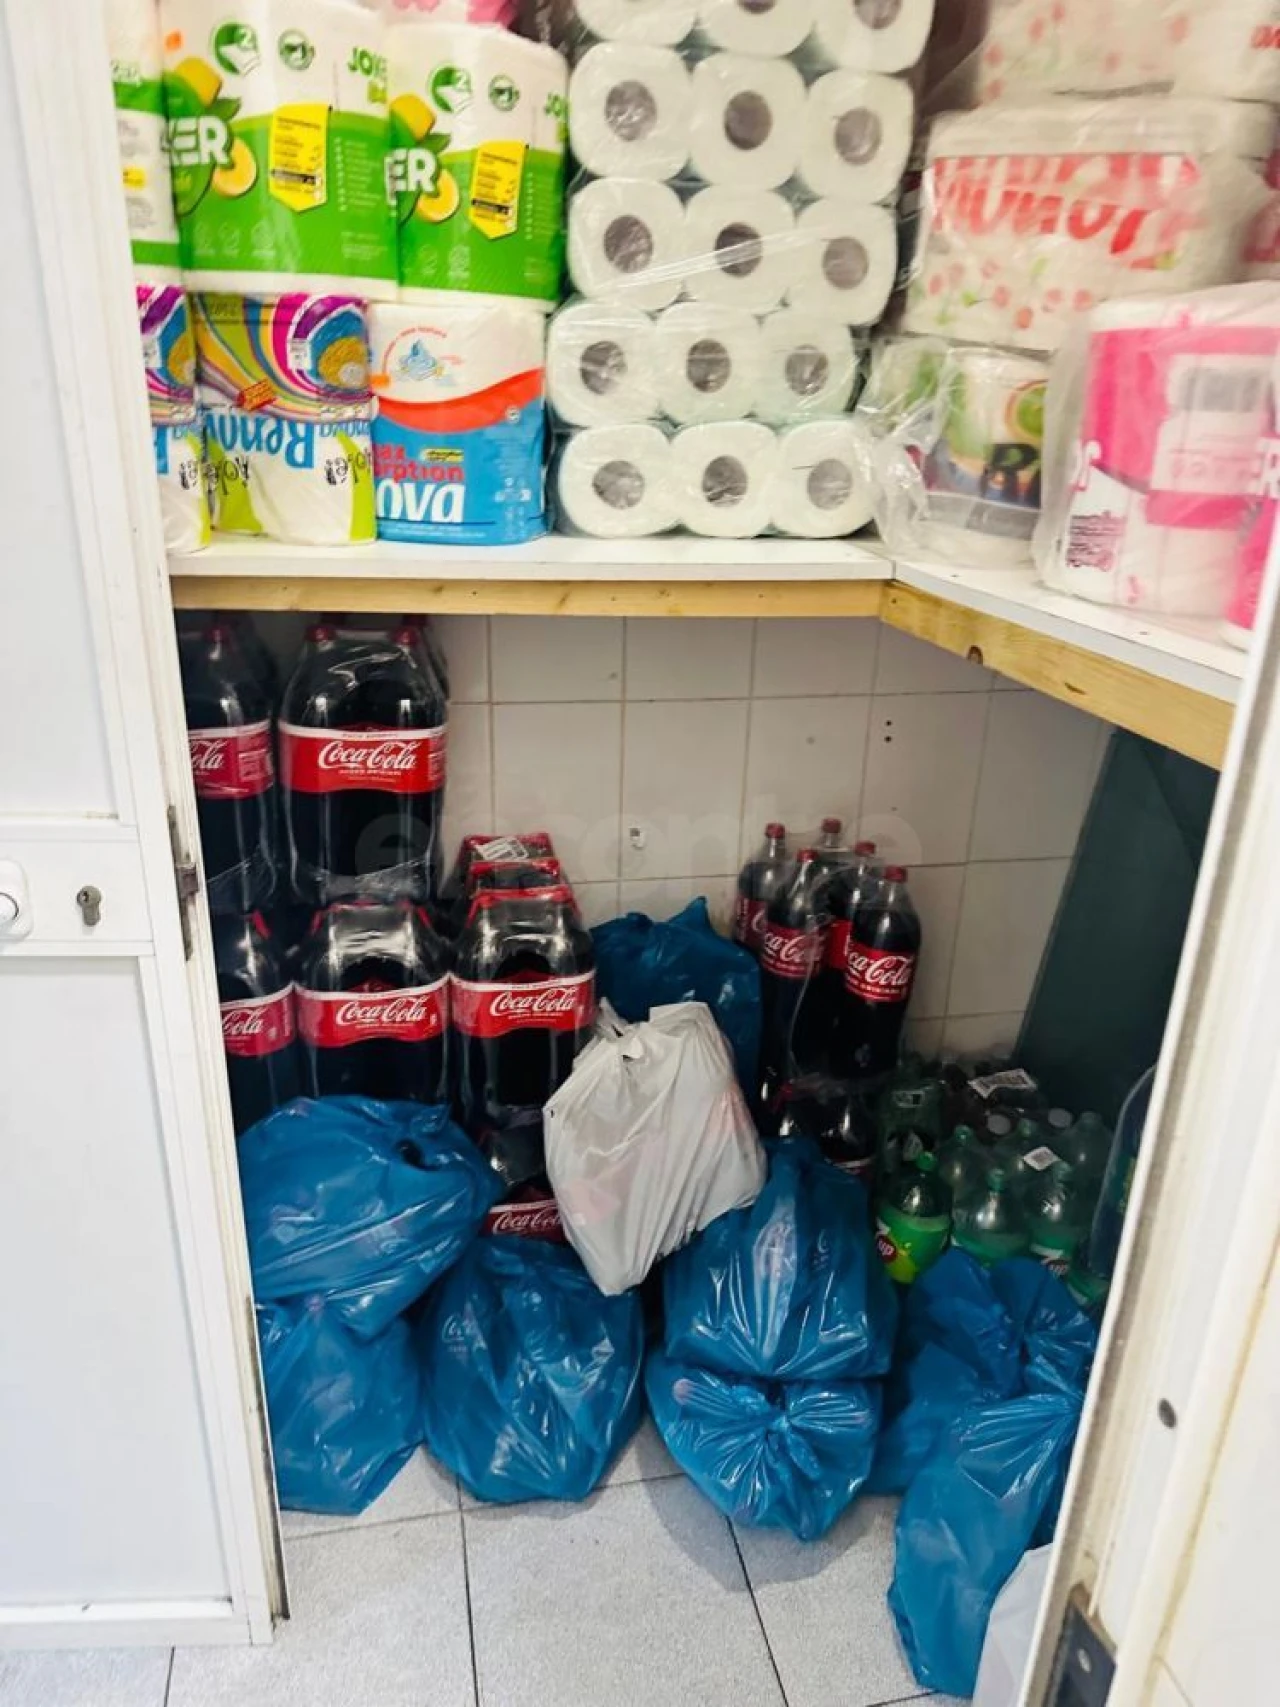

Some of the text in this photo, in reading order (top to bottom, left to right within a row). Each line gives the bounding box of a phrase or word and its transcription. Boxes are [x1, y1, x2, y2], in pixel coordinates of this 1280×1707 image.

[318, 739, 422, 770] Coca-Cola
[335, 994, 430, 1026] Coca-Cola
[490, 986, 578, 1017] Coca-Cola
